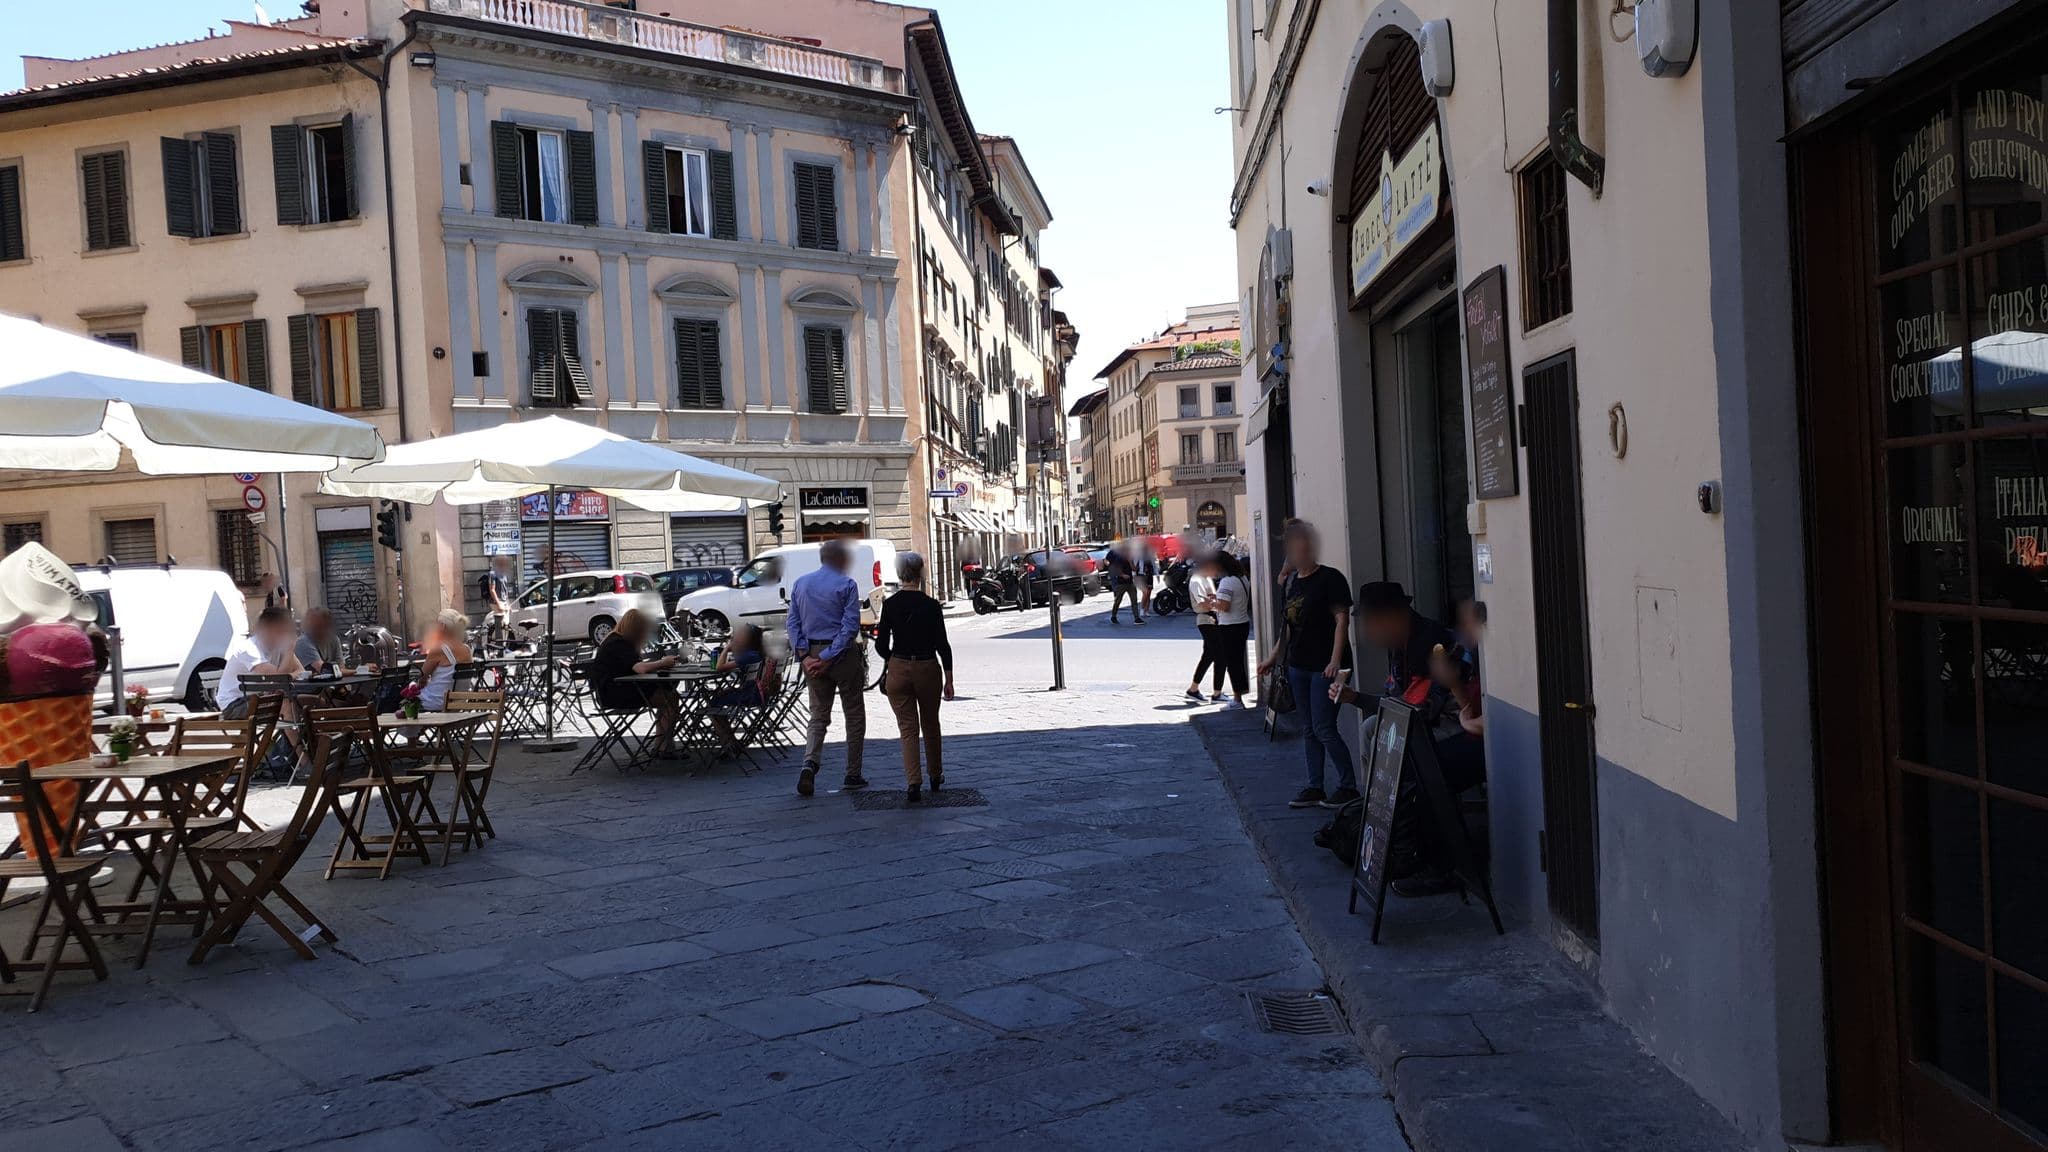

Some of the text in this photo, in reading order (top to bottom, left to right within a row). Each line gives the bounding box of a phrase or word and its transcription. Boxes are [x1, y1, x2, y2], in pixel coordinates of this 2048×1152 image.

[1893, 89, 2045, 202] COME IN AND TRY
[1891, 190, 1915, 250] OUR
[1918, 153, 1955, 214] BEER
[1896, 310, 1950, 358] SPECIAL
[1988, 286, 2034, 336] CHIPS
[1890, 359, 1960, 404] COCKTAILS
[1995, 476, 2048, 520] ITALIA
[1902, 505, 1962, 544] ORIGINAL
